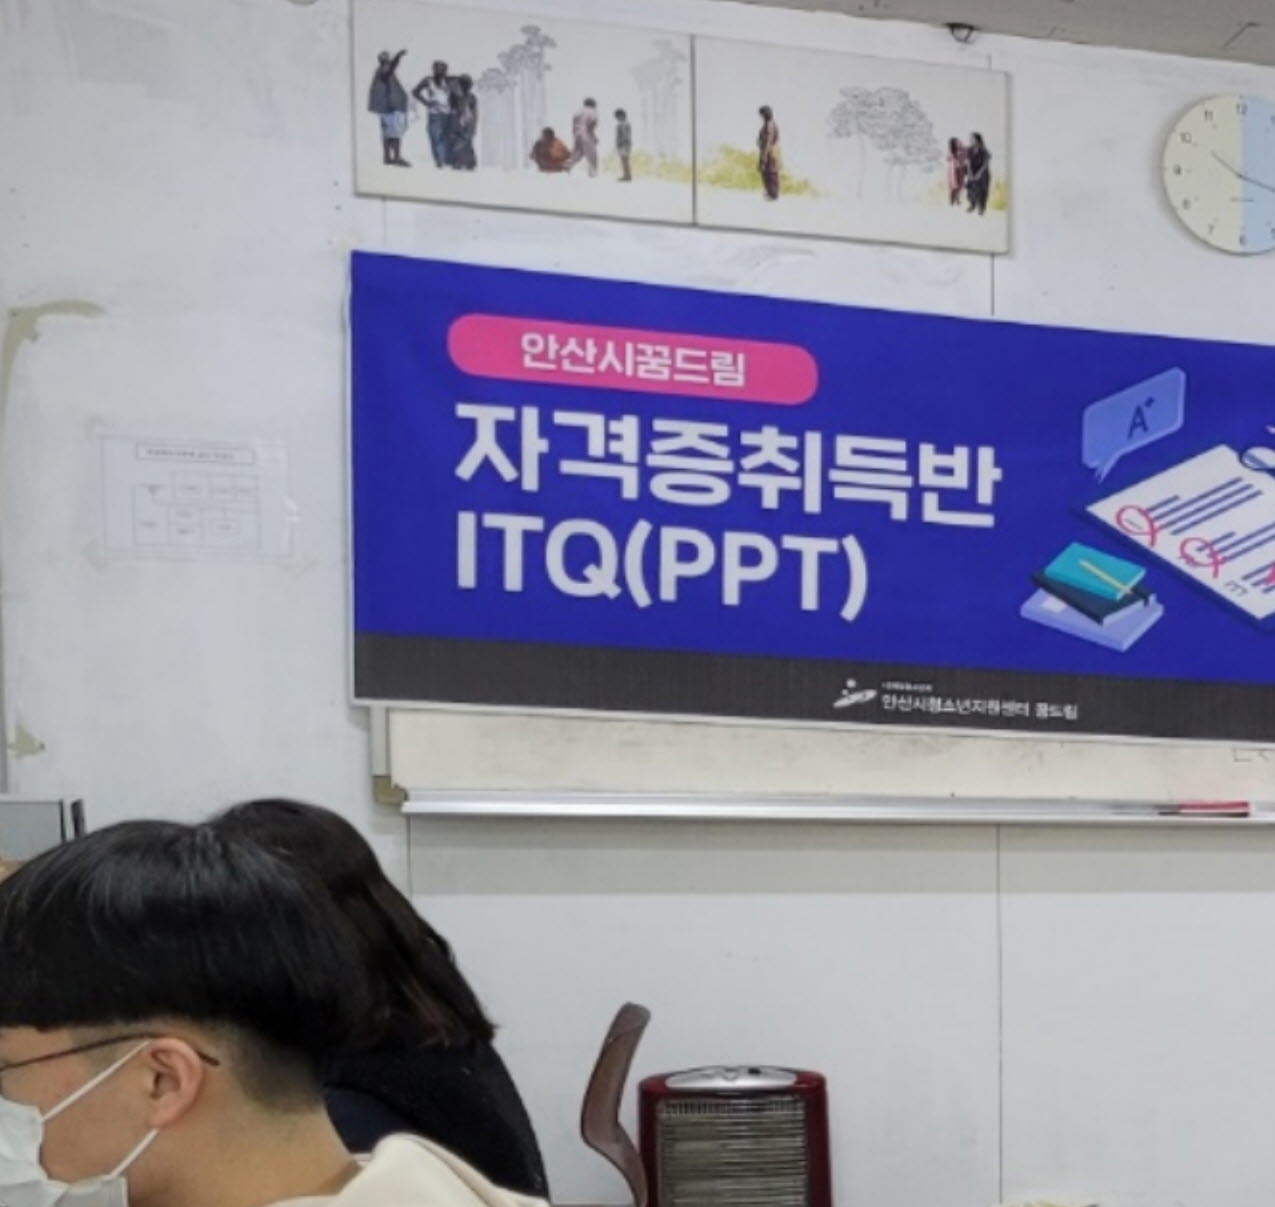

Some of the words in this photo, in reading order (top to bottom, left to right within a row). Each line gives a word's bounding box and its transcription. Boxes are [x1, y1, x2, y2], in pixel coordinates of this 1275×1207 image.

[521, 332, 746, 387] 안산시꿈드림
[454, 402, 1003, 528] 자격증취득반
[457, 510, 869, 622] ITQ(PPT)
